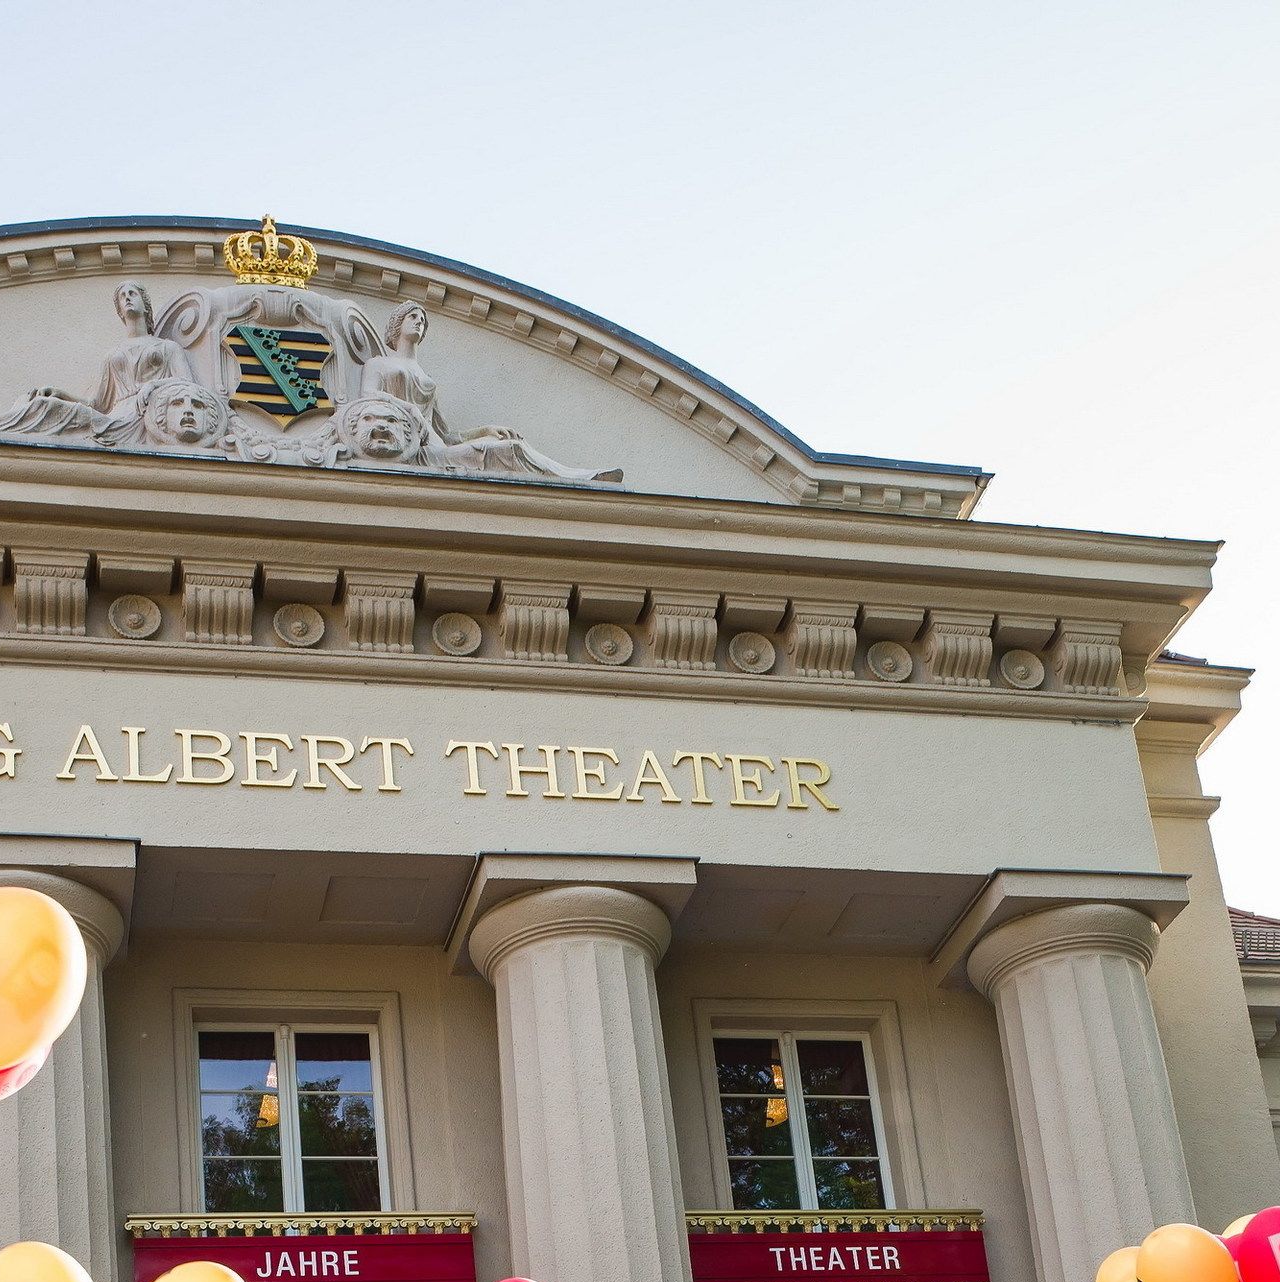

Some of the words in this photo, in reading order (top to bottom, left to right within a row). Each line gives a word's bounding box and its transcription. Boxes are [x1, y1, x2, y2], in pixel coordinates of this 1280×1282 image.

[56, 724, 414, 791] ALBERT
[445, 739, 839, 810] THEATER
[256, 1250, 360, 1278] JAHRE
[769, 1246, 901, 1271] THEATER
